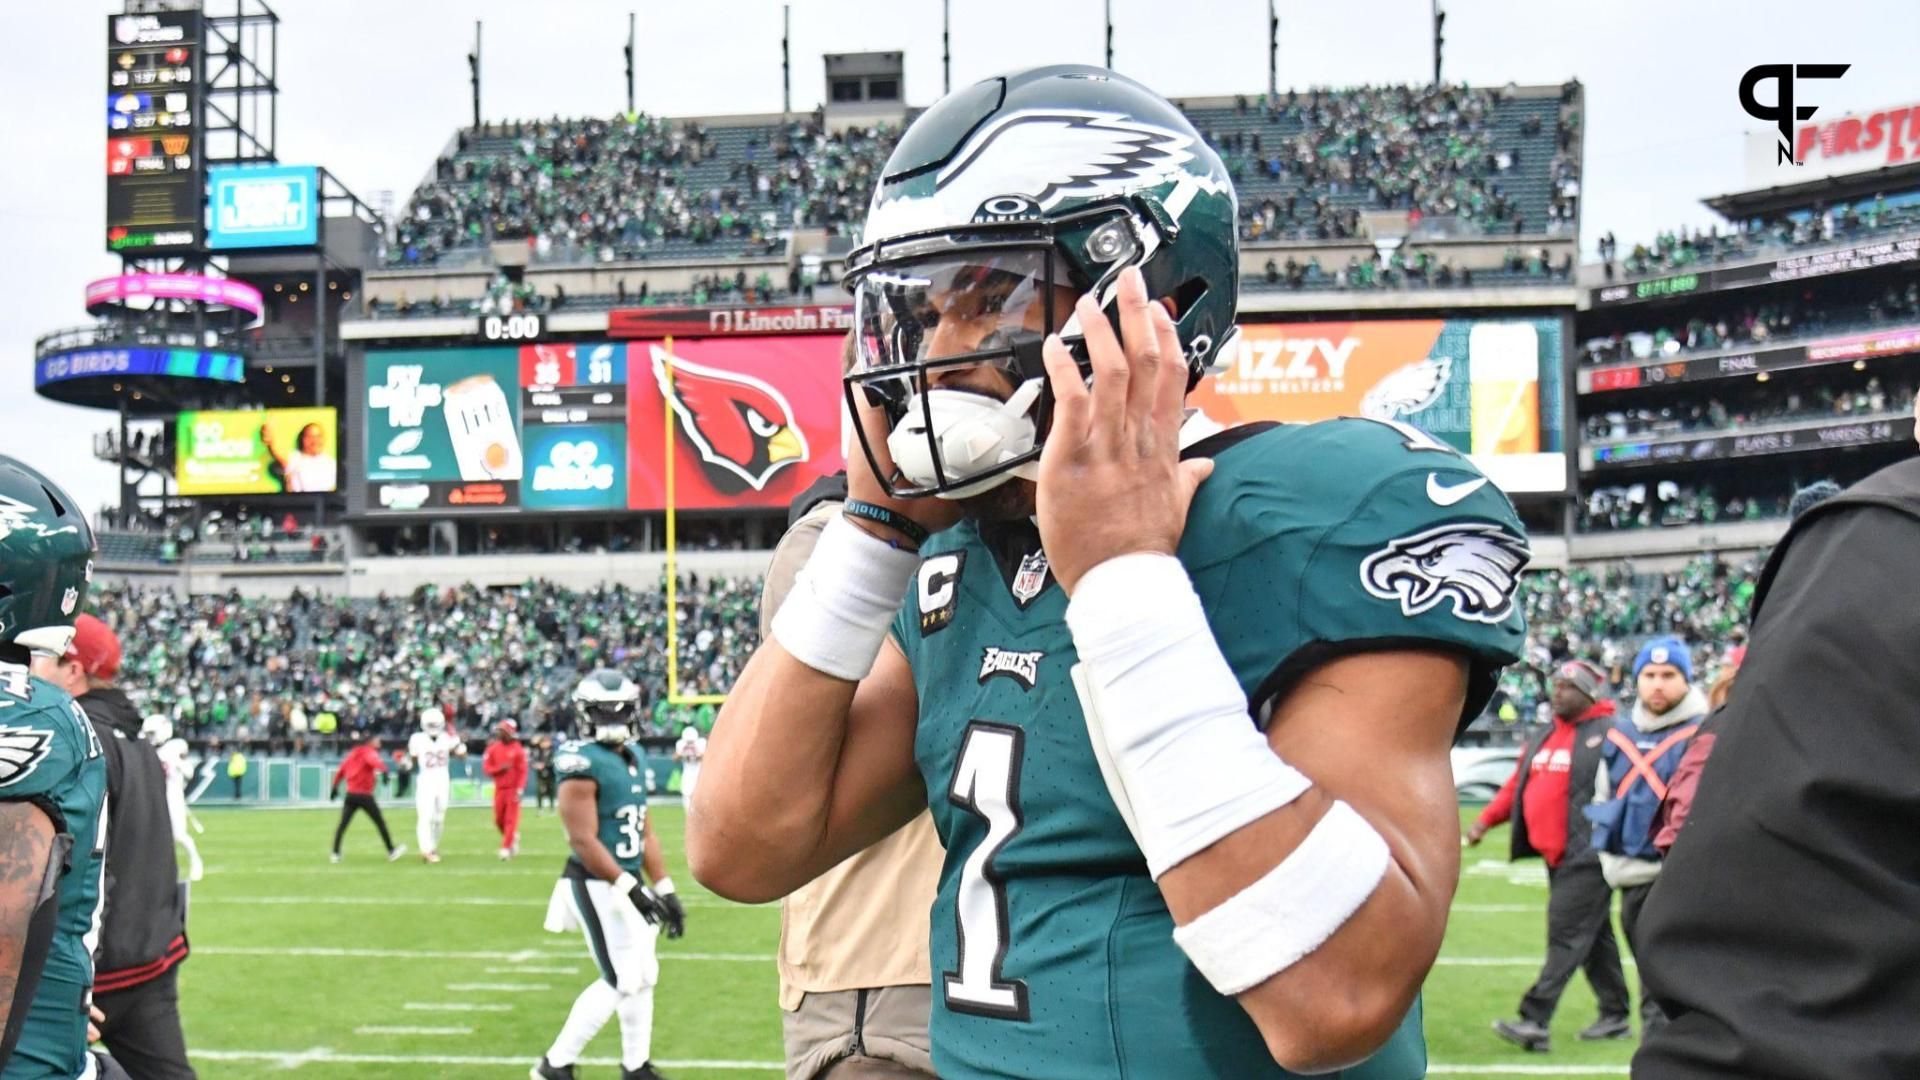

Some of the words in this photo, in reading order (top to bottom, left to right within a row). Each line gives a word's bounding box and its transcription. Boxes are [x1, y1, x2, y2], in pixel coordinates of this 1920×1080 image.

[485, 315, 540, 340] 0:00
[734, 309, 817, 332] Lincoln
[70, 350, 130, 375] BIRDS
[1216, 337, 1362, 379] IZZY
[918, 555, 959, 614] C
[979, 646, 1046, 686] EAGLES
[944, 720, 1030, 1020] 1
